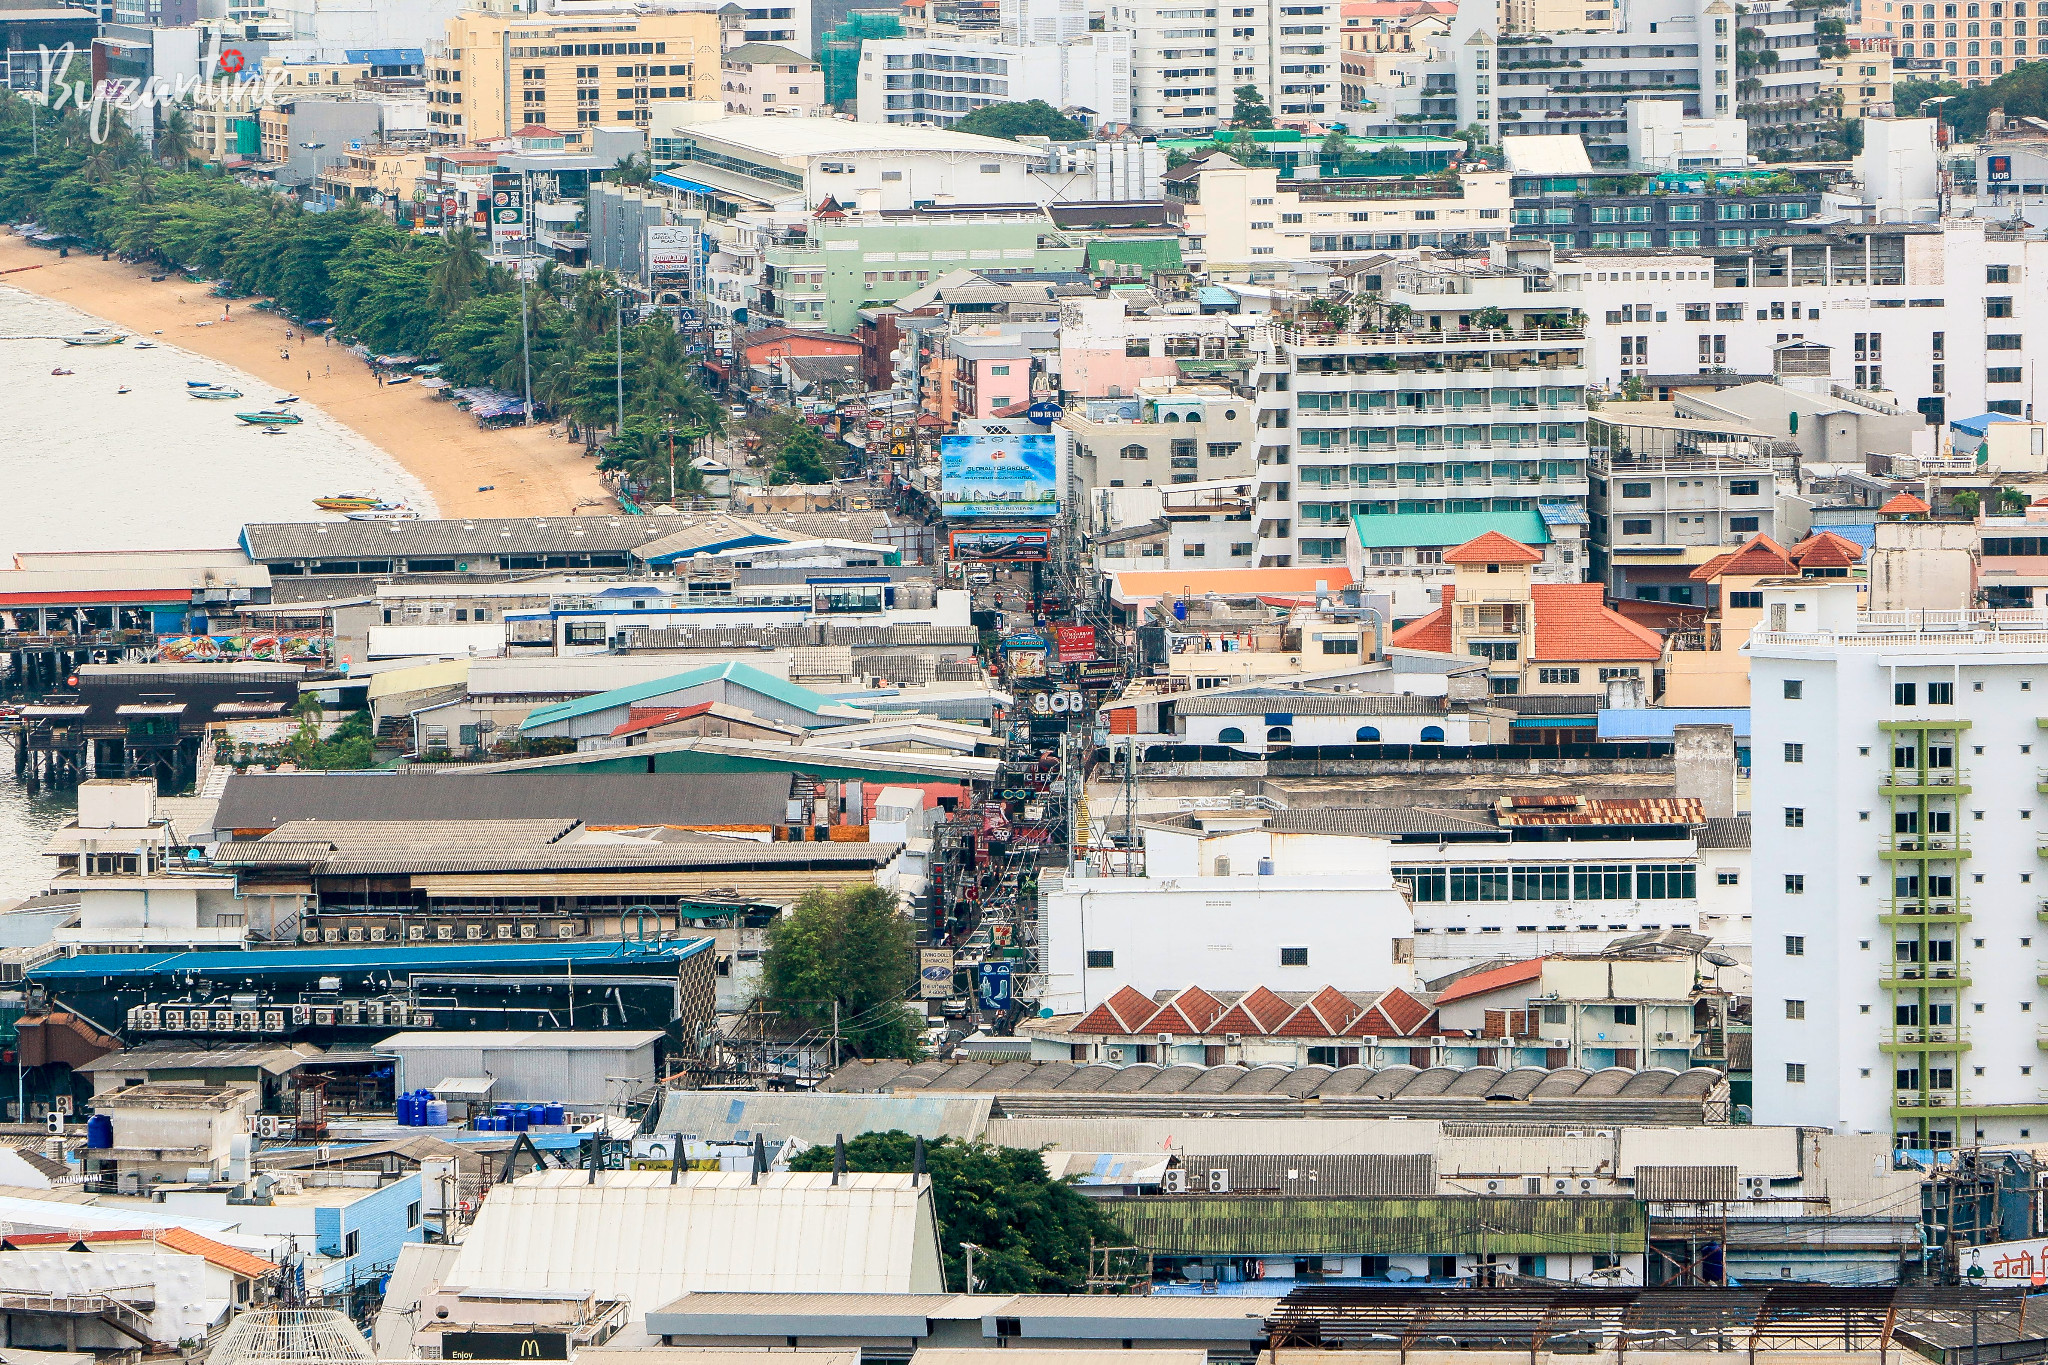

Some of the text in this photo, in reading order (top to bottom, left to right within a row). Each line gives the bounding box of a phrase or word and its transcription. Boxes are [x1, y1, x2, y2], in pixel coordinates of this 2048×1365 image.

[1992, 172, 2010, 180] UOB
[1035, 692, 1083, 712] 808
[1993, 1250, 2031, 1278] टोनी
[452, 1350, 474, 1360] Enjoy
